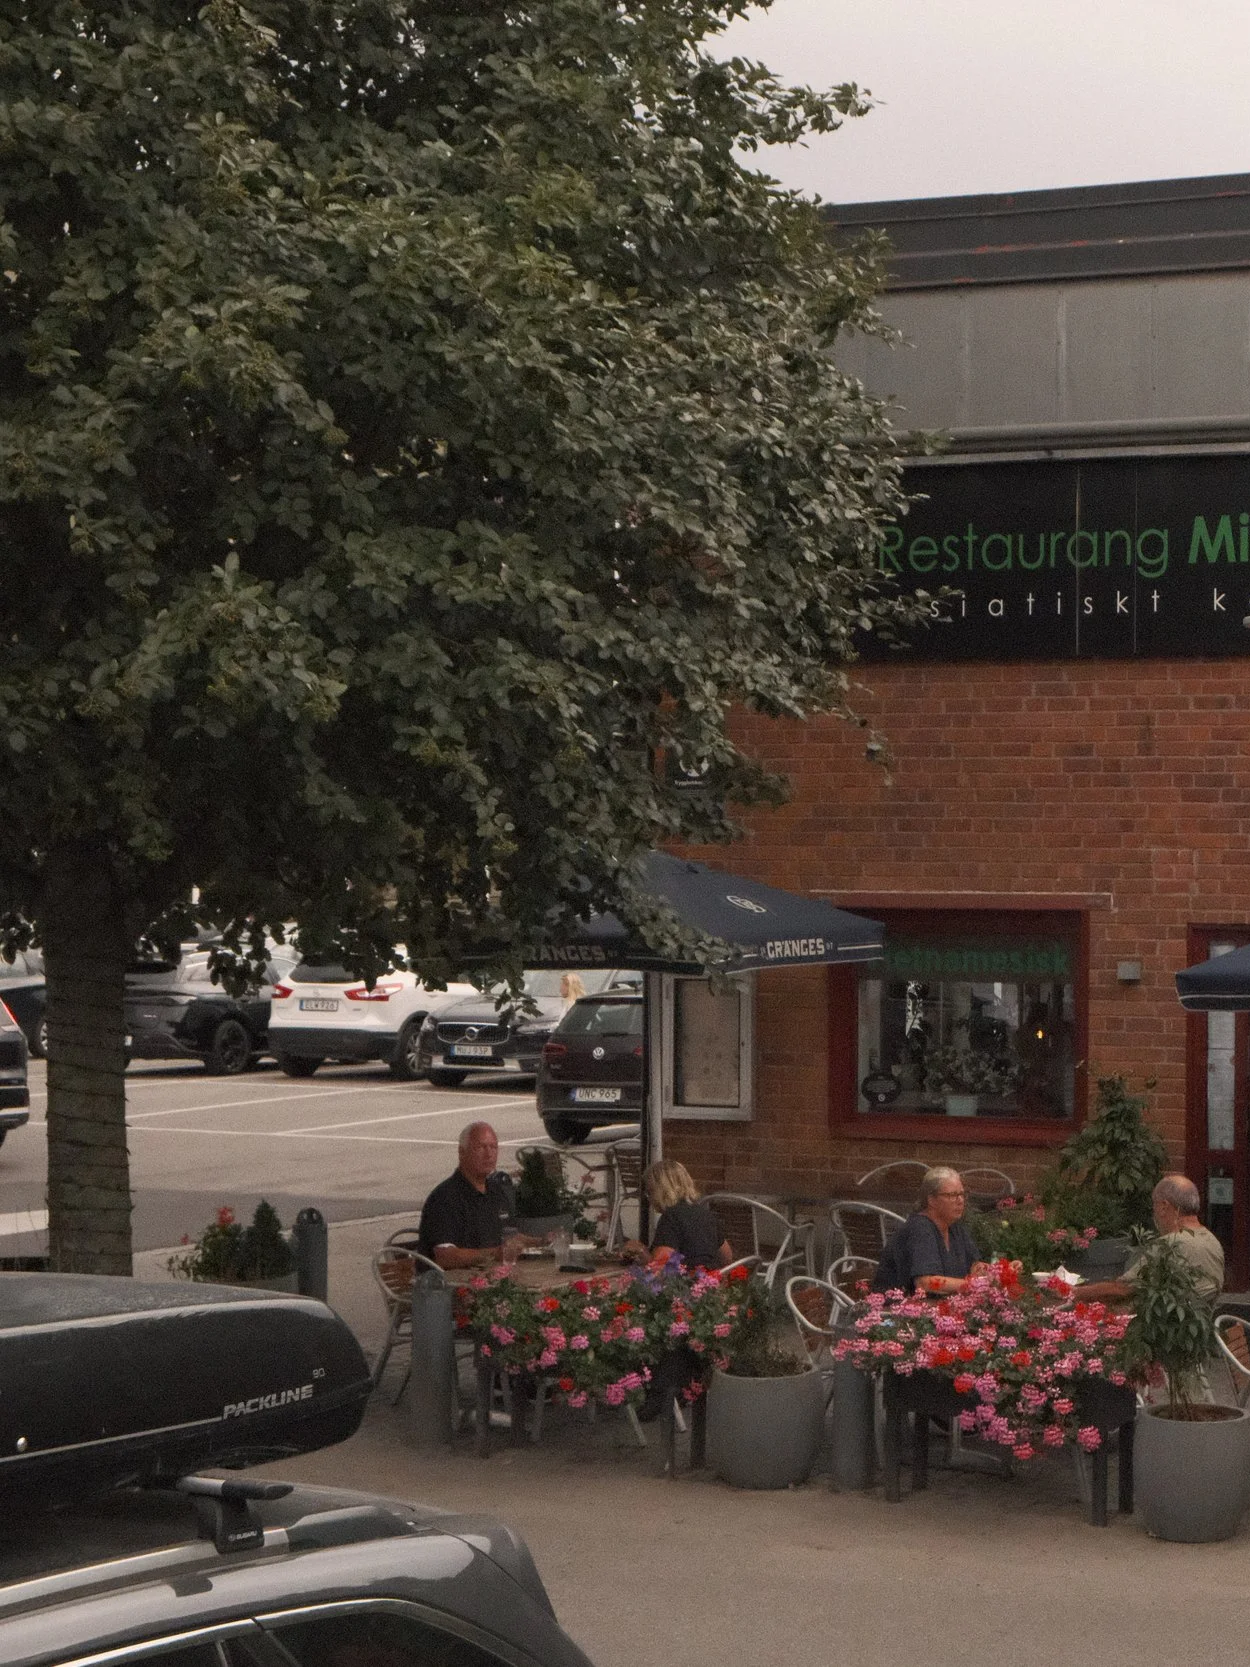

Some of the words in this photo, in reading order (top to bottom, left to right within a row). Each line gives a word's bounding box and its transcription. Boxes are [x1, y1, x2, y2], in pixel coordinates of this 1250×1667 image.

[879, 522, 1169, 578] Restaurang
[895, 588, 1160, 617] siatiskt
[579, 1088, 597, 1098] UNC
[599, 1088, 617, 1099] 965
[222, 1383, 314, 1420] PACKLINE
